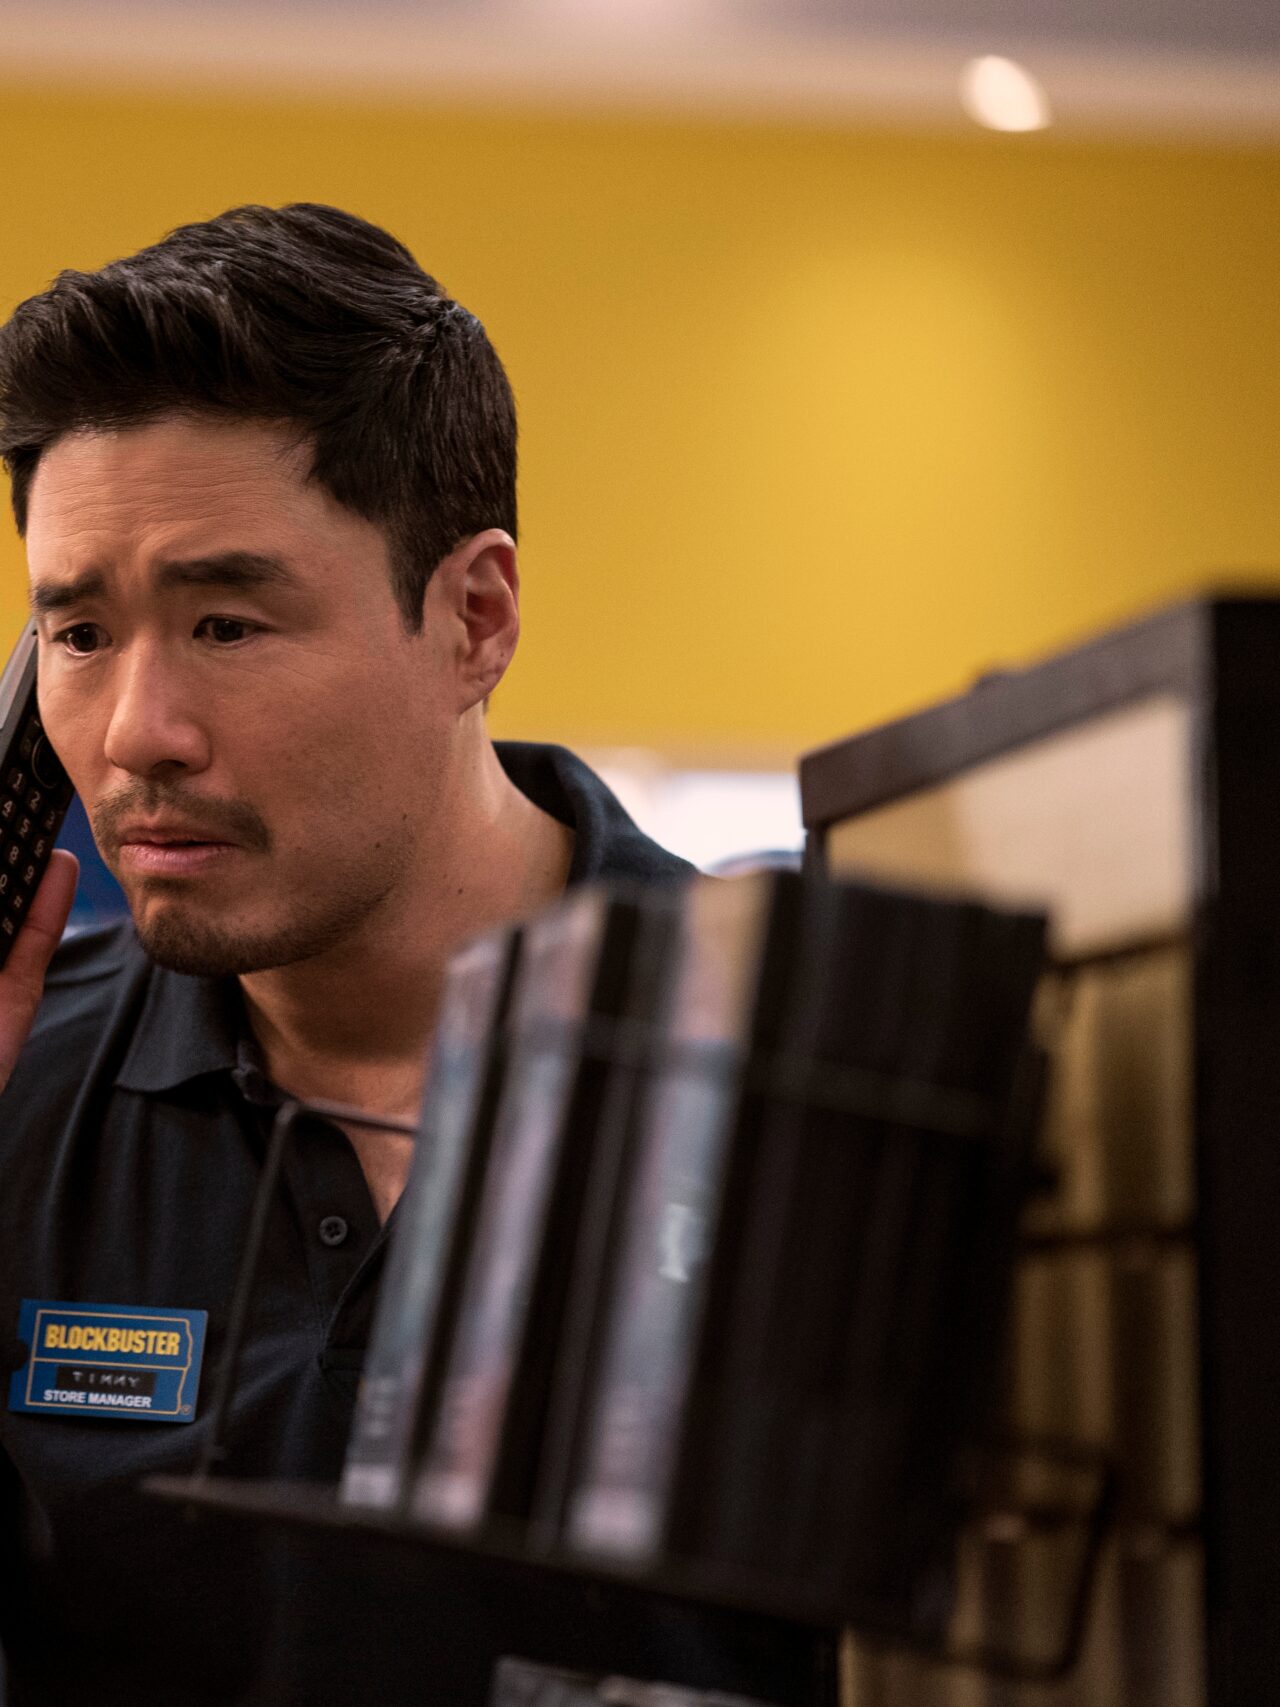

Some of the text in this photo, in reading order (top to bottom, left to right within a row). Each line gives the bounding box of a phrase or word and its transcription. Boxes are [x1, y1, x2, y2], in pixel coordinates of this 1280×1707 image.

[10, 845, 19, 861] 8
[44, 1324, 181, 1356] BLOCKBUSTER
[72, 1371, 140, 1388] TIMMY
[43, 1389, 152, 1408] STORE MANAGER
